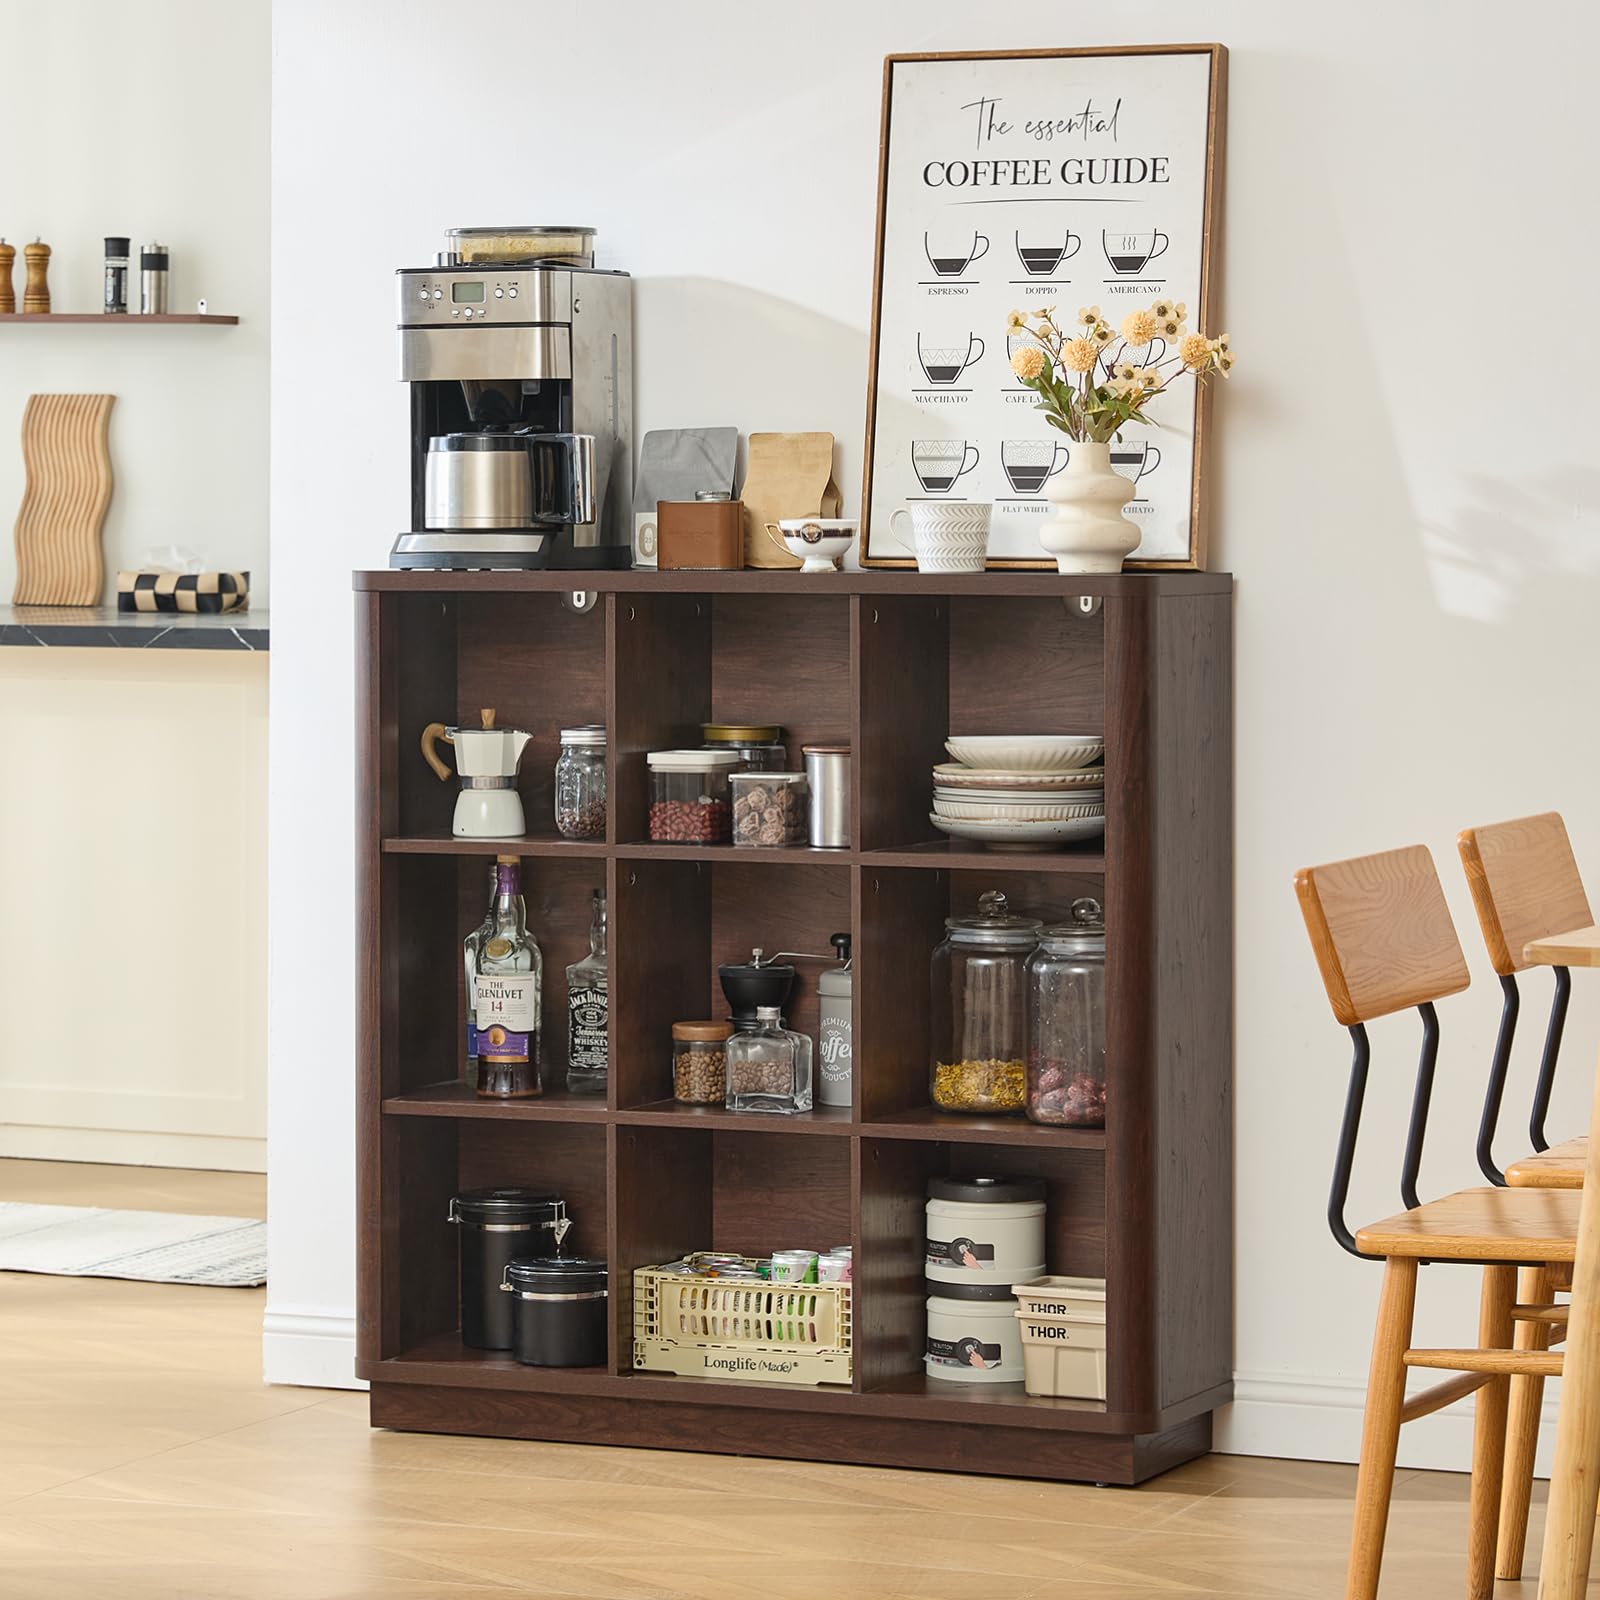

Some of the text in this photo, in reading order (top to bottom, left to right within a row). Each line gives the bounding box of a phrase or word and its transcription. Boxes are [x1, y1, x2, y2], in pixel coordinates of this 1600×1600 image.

[960, 96, 1122, 150] The essential
[923, 157, 1170, 187] COFFEE GUIDE
[928, 287, 969, 296] ESPRESSO
[1025, 286, 1057, 295] DOPPIO
[1107, 285, 1161, 294] AMERICANO
[914, 395, 968, 403] MACCHIATO
[478, 988, 523, 1000] GLENLIVET
[570, 990, 608, 1009] JACK DANIE
[491, 1001, 503, 1012] 14
[574, 1038, 608, 1047] WHISKEY
[704, 1355, 757, 1373] Longlife
